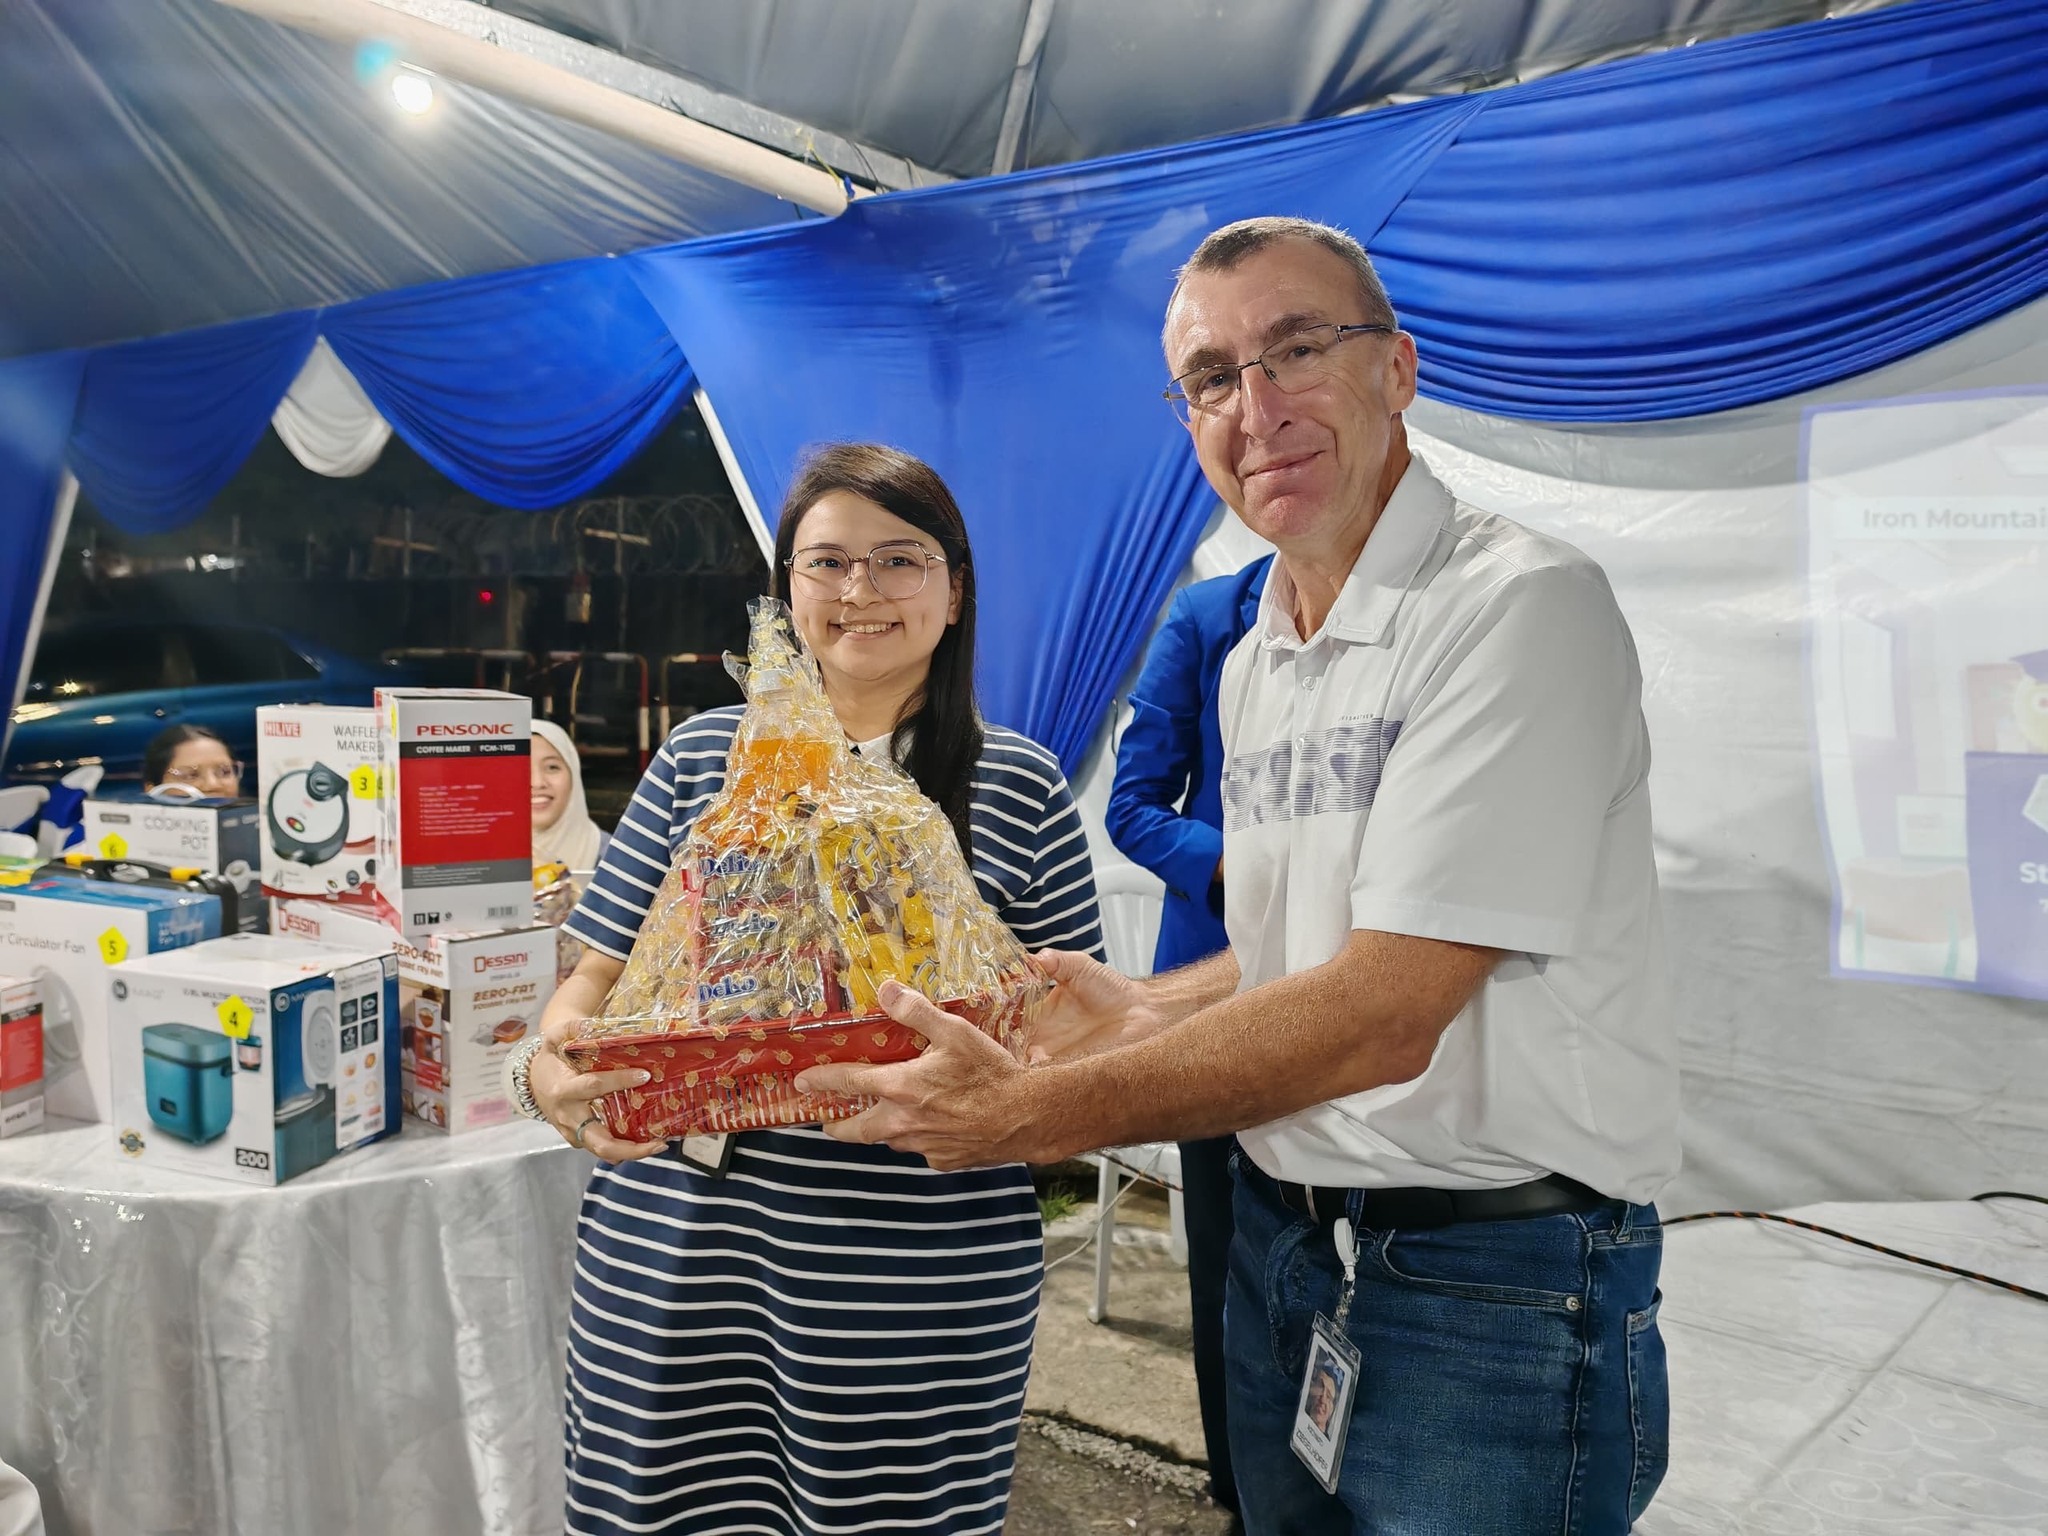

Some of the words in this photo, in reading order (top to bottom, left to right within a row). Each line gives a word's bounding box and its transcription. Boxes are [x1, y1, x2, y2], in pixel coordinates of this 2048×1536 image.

[1863, 508, 1917, 528] Iron
[1926, 507, 2048, 529] Mountai
[333, 724, 375, 739] WAFFLE
[416, 723, 514, 736] PENSONIC
[336, 740, 376, 753] MAKER
[416, 746, 444, 754] COFFEE
[445, 745, 471, 753] MAKER
[359, 776, 368, 791] 3
[144, 815, 208, 834] COOKING
[181, 835, 209, 850] POT
[8, 932, 63, 952] Circulator
[64, 940, 86, 954] Fan
[109, 939, 117, 957] 5
[228, 1011, 238, 1028] 4
[237, 1150, 269, 1169] 200
